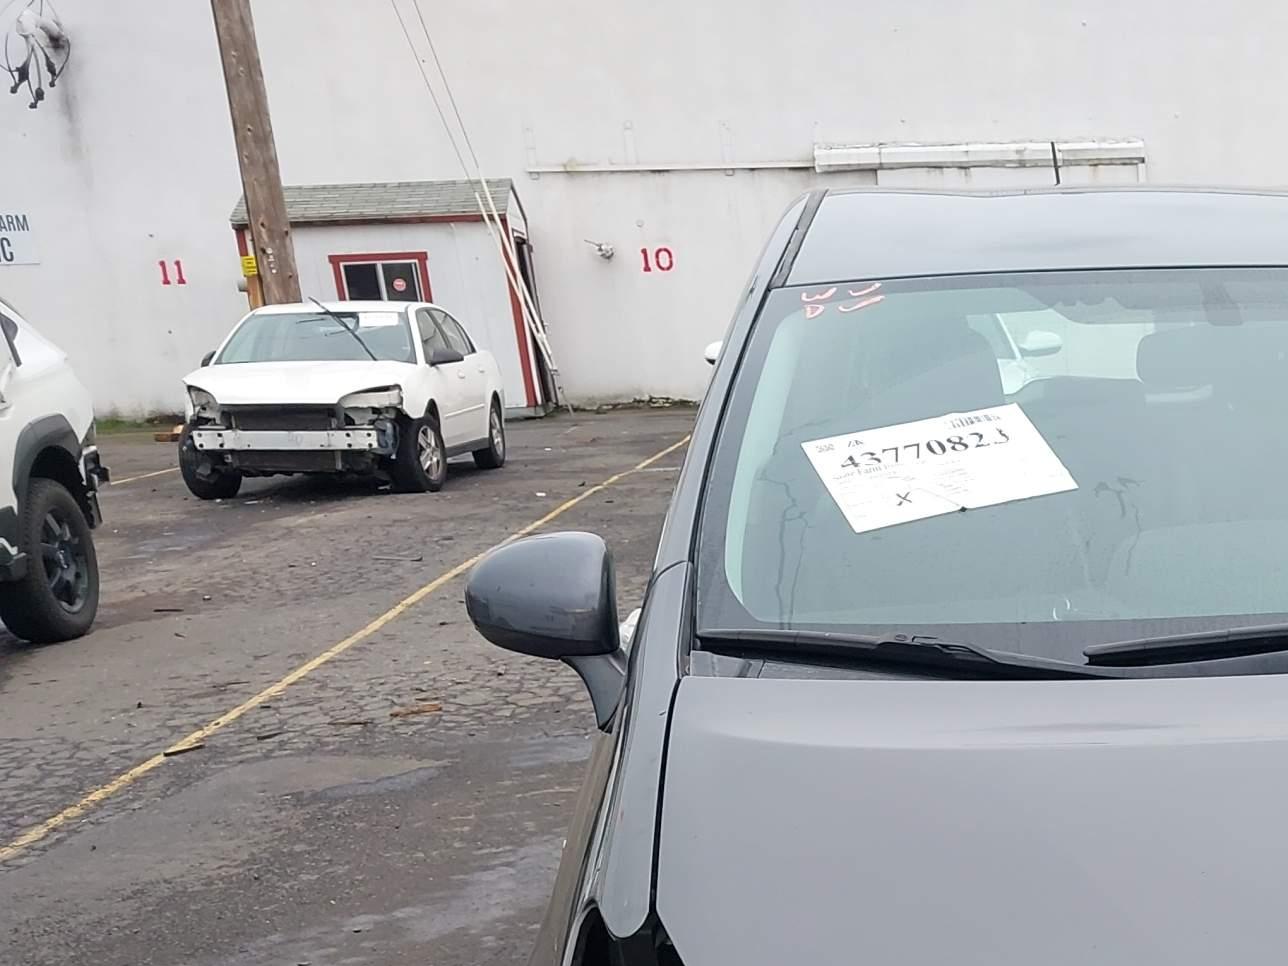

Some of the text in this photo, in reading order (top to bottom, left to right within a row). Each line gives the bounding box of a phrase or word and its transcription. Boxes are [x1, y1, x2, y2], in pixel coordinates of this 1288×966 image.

[0, 237, 14, 262] C
[641, 247, 673, 272] 10
[158, 260, 187, 285] 11
